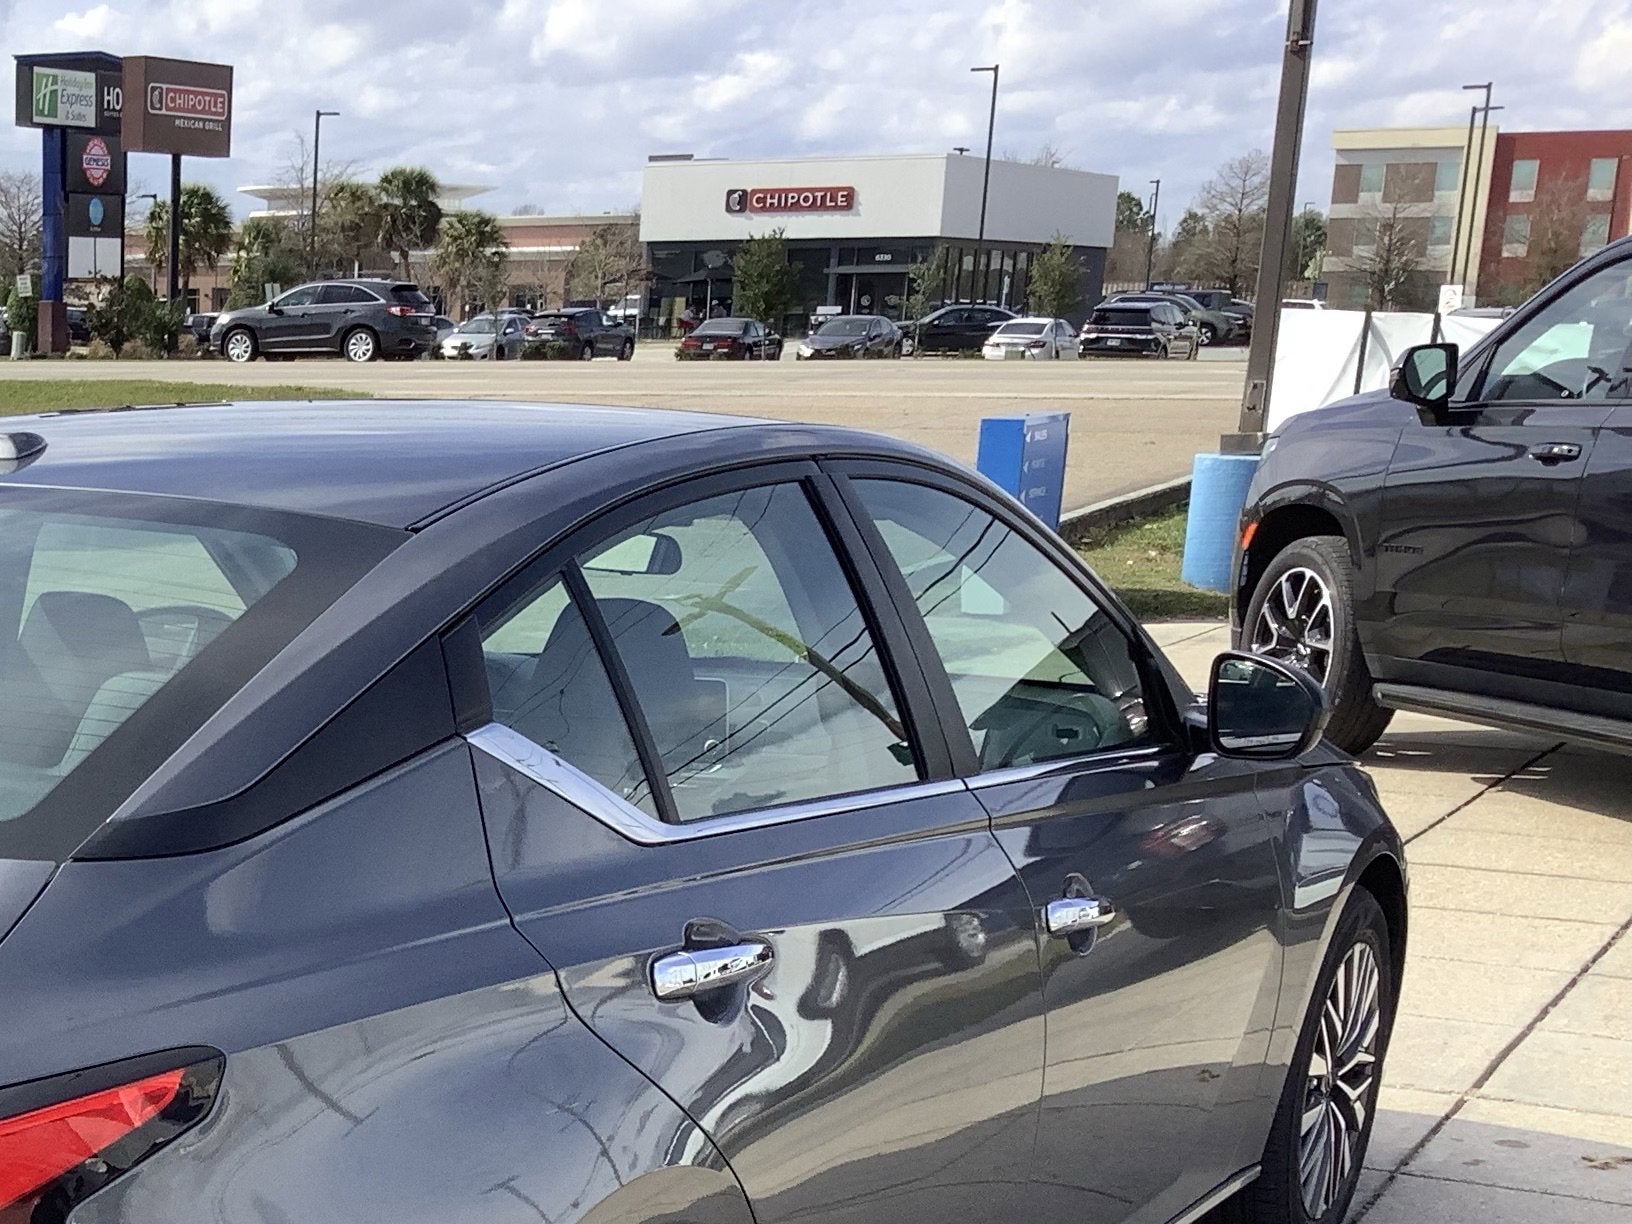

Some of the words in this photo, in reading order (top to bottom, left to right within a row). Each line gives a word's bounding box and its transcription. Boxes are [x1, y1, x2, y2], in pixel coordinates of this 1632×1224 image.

[60, 89, 93, 109] Express
[167, 92, 224, 113] CHIPOTLE
[175, 119, 203, 129] MEXICAN
[204, 121, 223, 132] GRILL
[752, 191, 849, 208] CHIPOTLE
